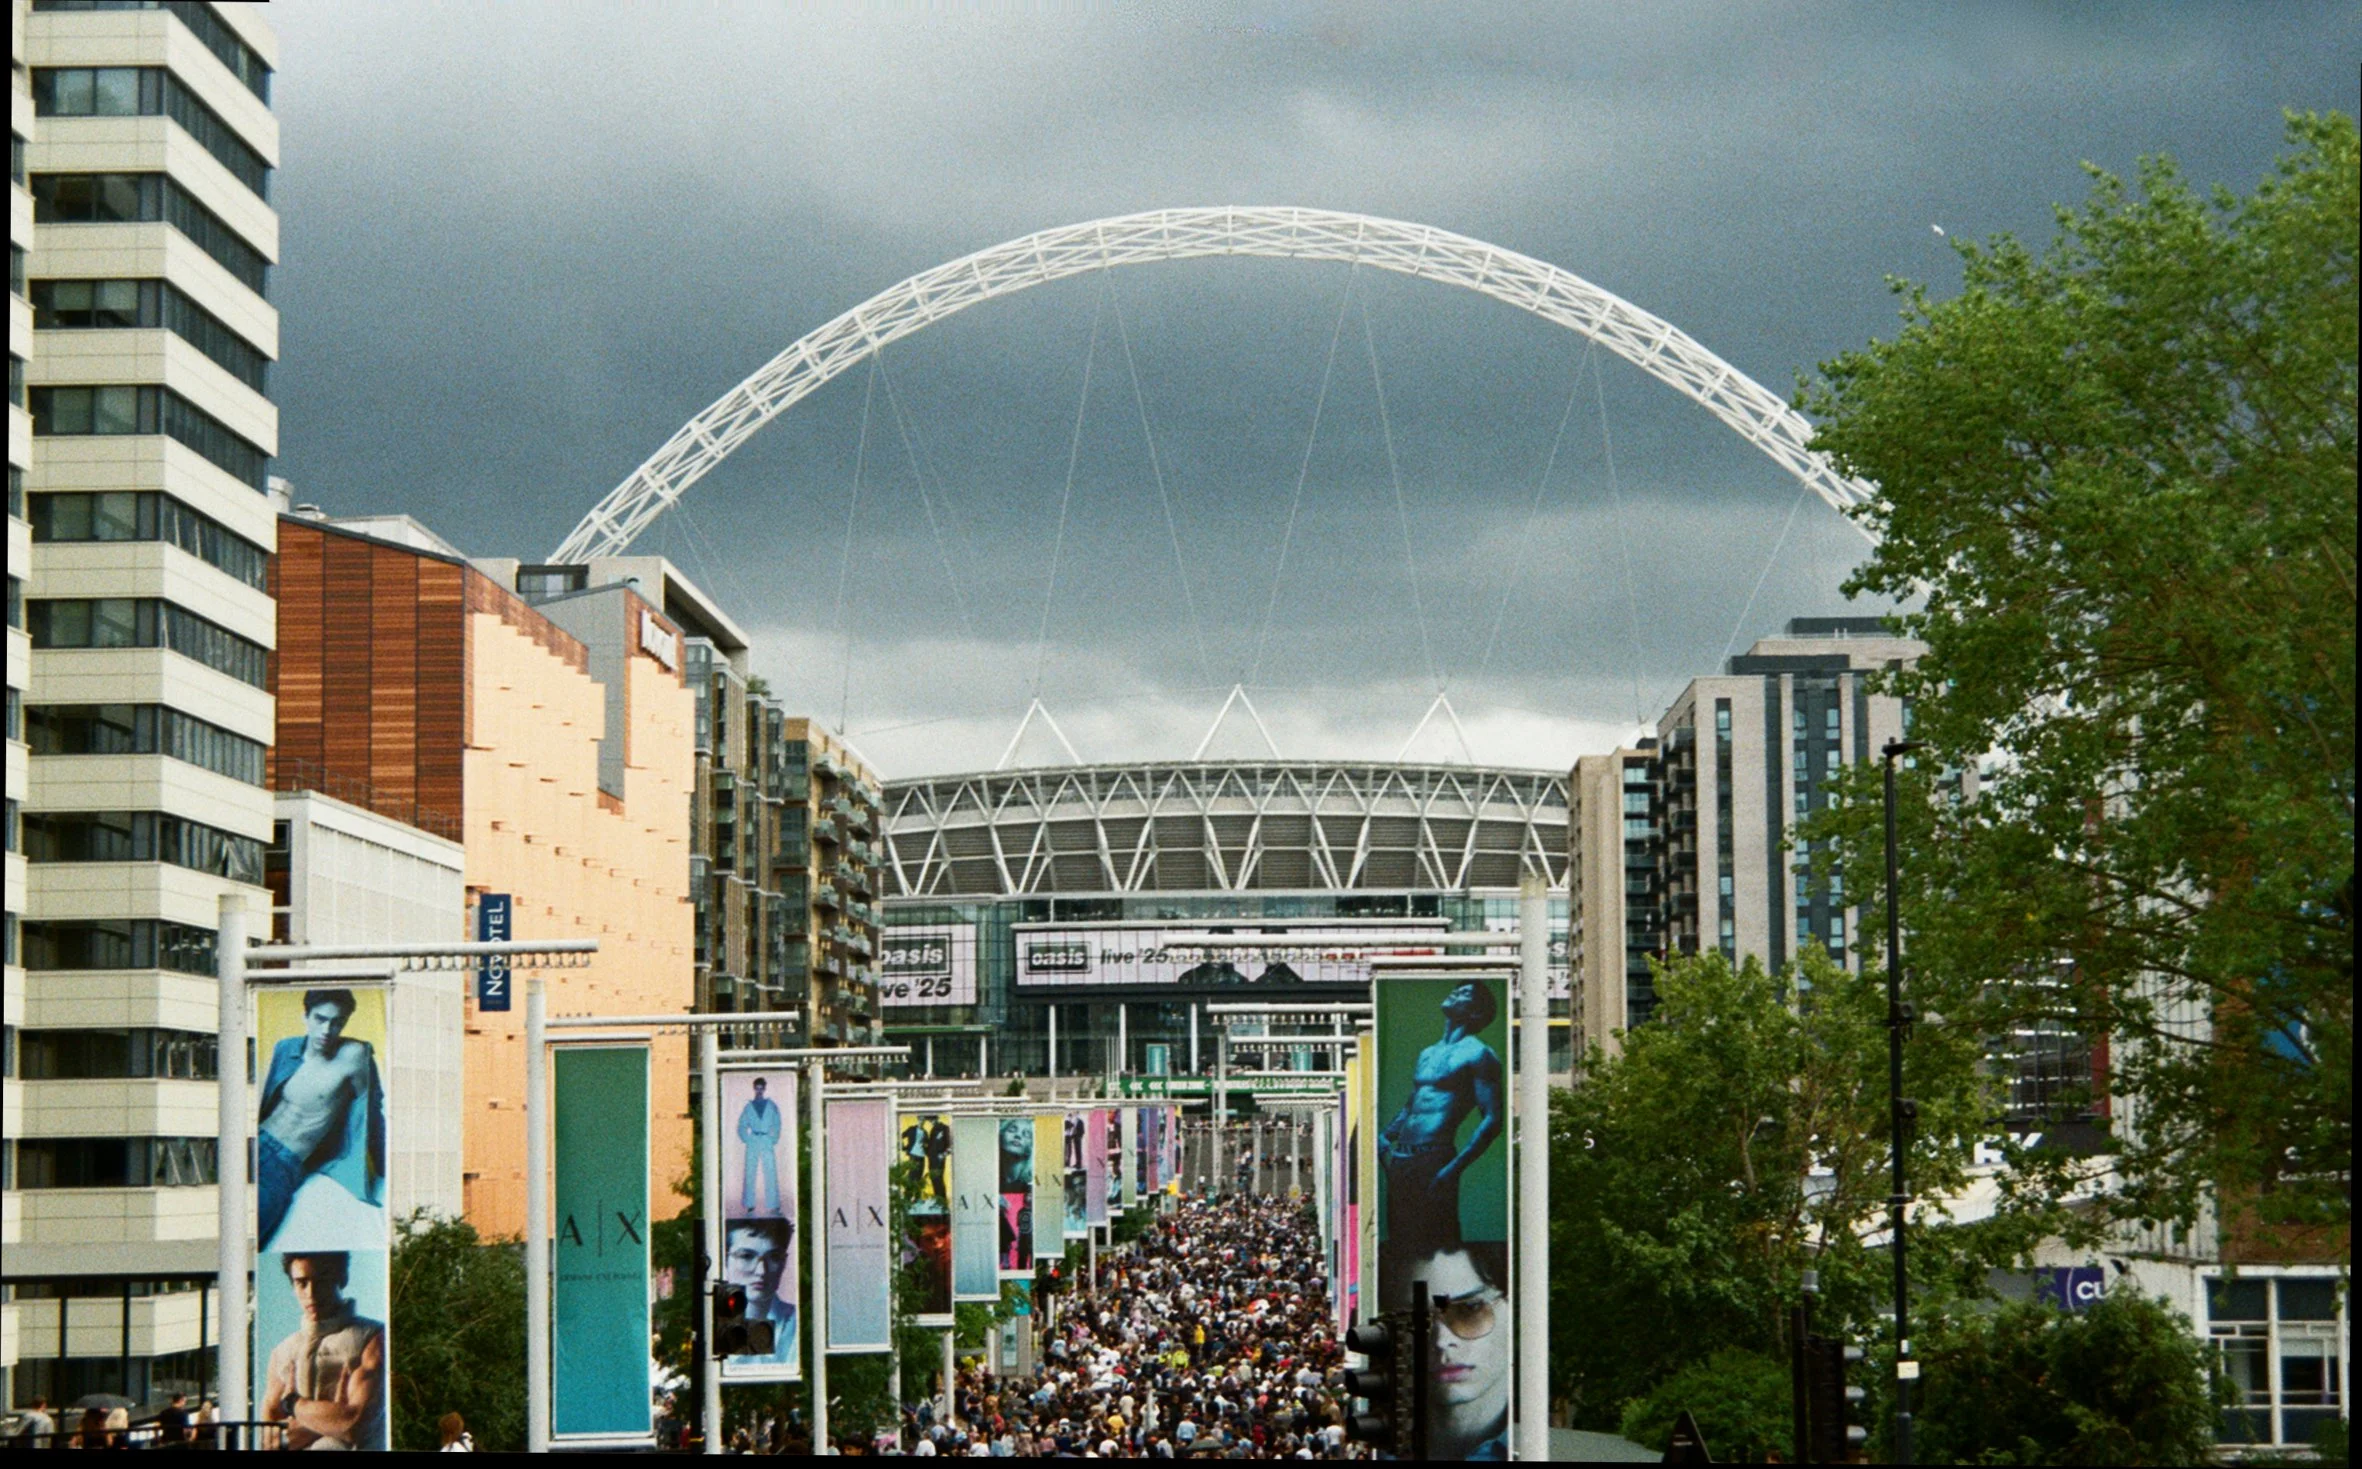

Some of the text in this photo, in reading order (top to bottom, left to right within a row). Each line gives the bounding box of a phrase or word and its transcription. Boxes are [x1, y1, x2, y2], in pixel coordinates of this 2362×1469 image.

[1031, 949, 1085, 966] oasis
[1101, 948, 1134, 964] live
[915, 976, 952, 997] '25
